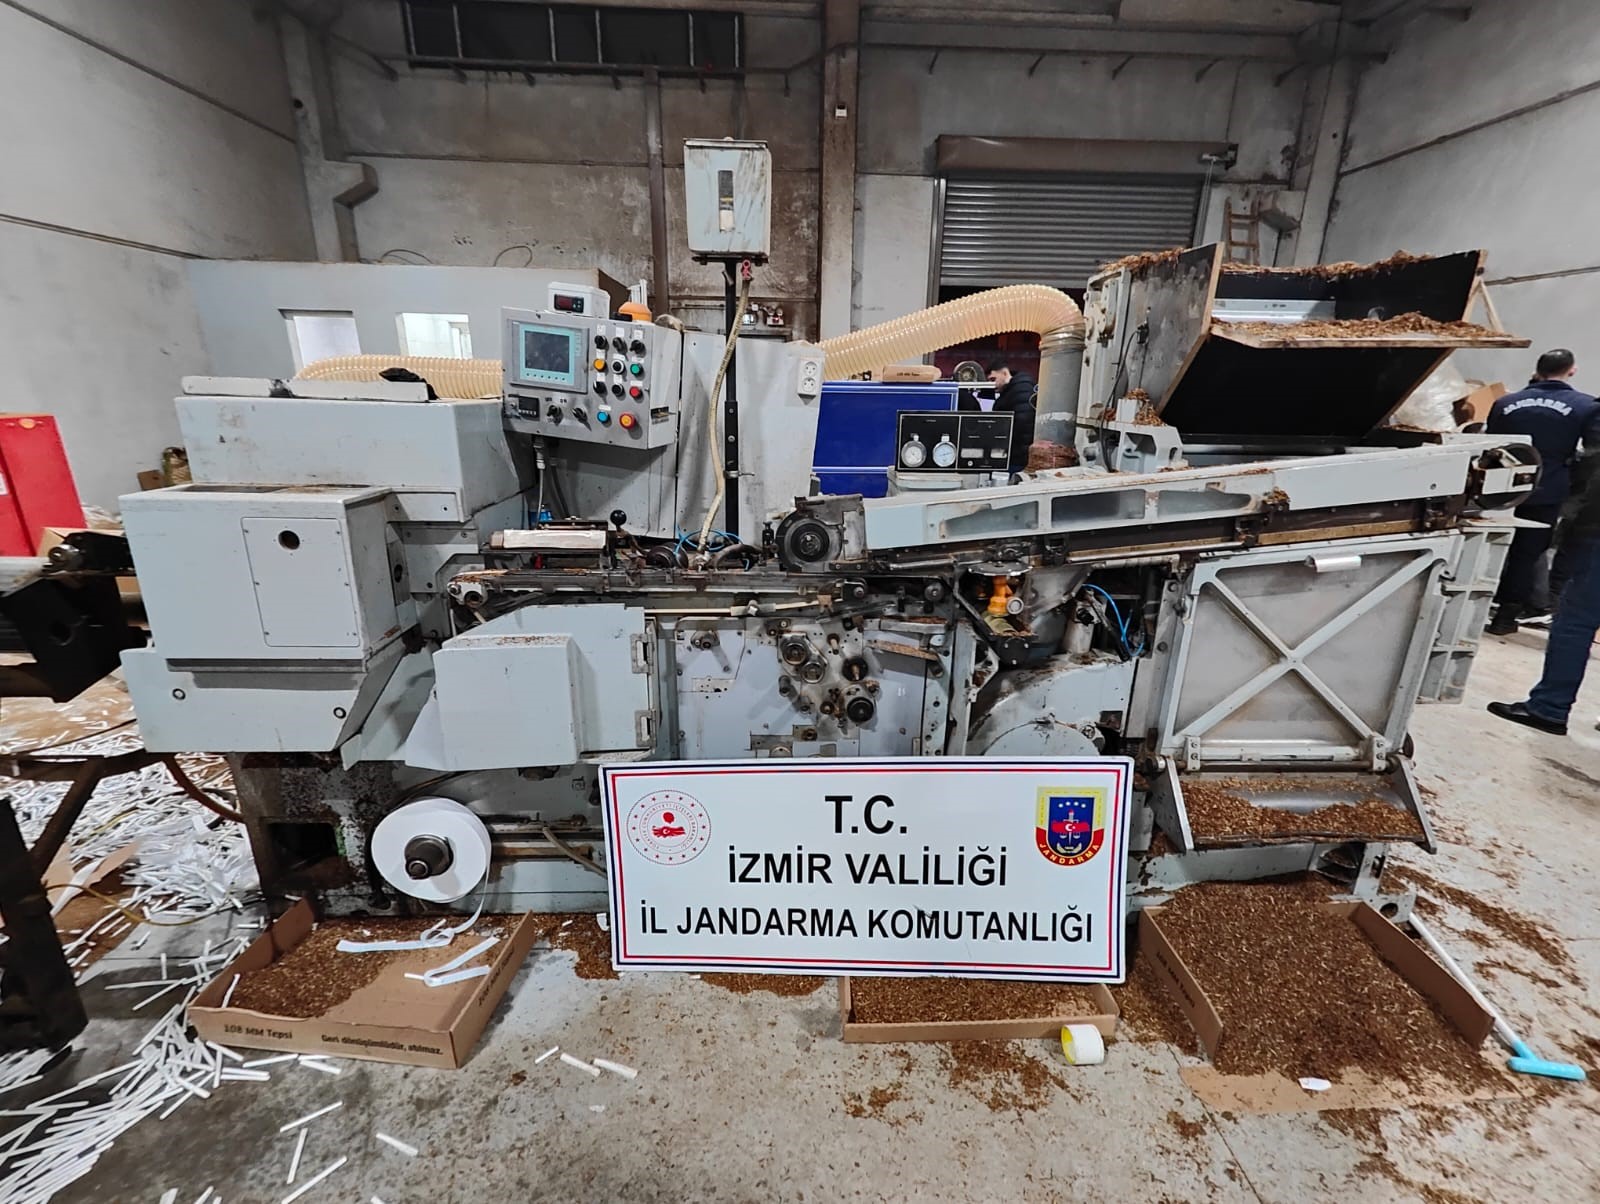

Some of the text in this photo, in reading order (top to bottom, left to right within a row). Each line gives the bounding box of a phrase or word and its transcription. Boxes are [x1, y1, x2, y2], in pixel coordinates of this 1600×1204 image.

[824, 795, 908, 834] T.C.
[729, 845, 1007, 887] İZMİR VALİLİĞİ
[1039, 843, 1100, 865] JANDARMA
[641, 900, 1093, 943] İL JANDARMA KOMUTANLIĞI
[267, 1028, 293, 1040] Tepsi
